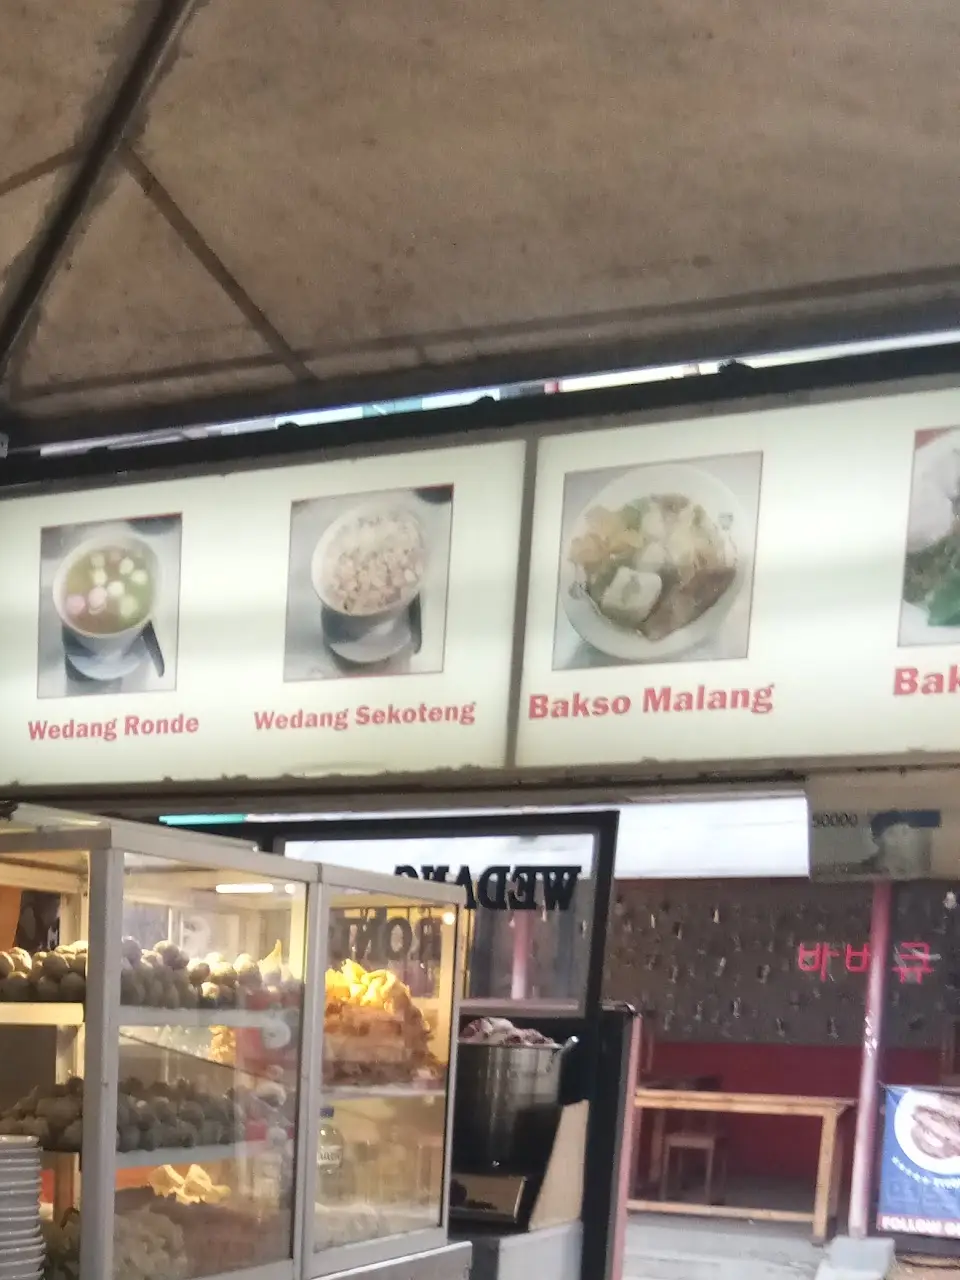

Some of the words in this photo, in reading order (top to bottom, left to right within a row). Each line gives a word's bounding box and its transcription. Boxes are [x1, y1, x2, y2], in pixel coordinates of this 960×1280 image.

[254, 708, 348, 731] Wedang
[355, 701, 476, 725] Sekoteng
[528, 692, 631, 720] Bakso
[643, 683, 775, 714] Malang
[28, 718, 117, 741] Wedang
[124, 713, 199, 736] Ronde
